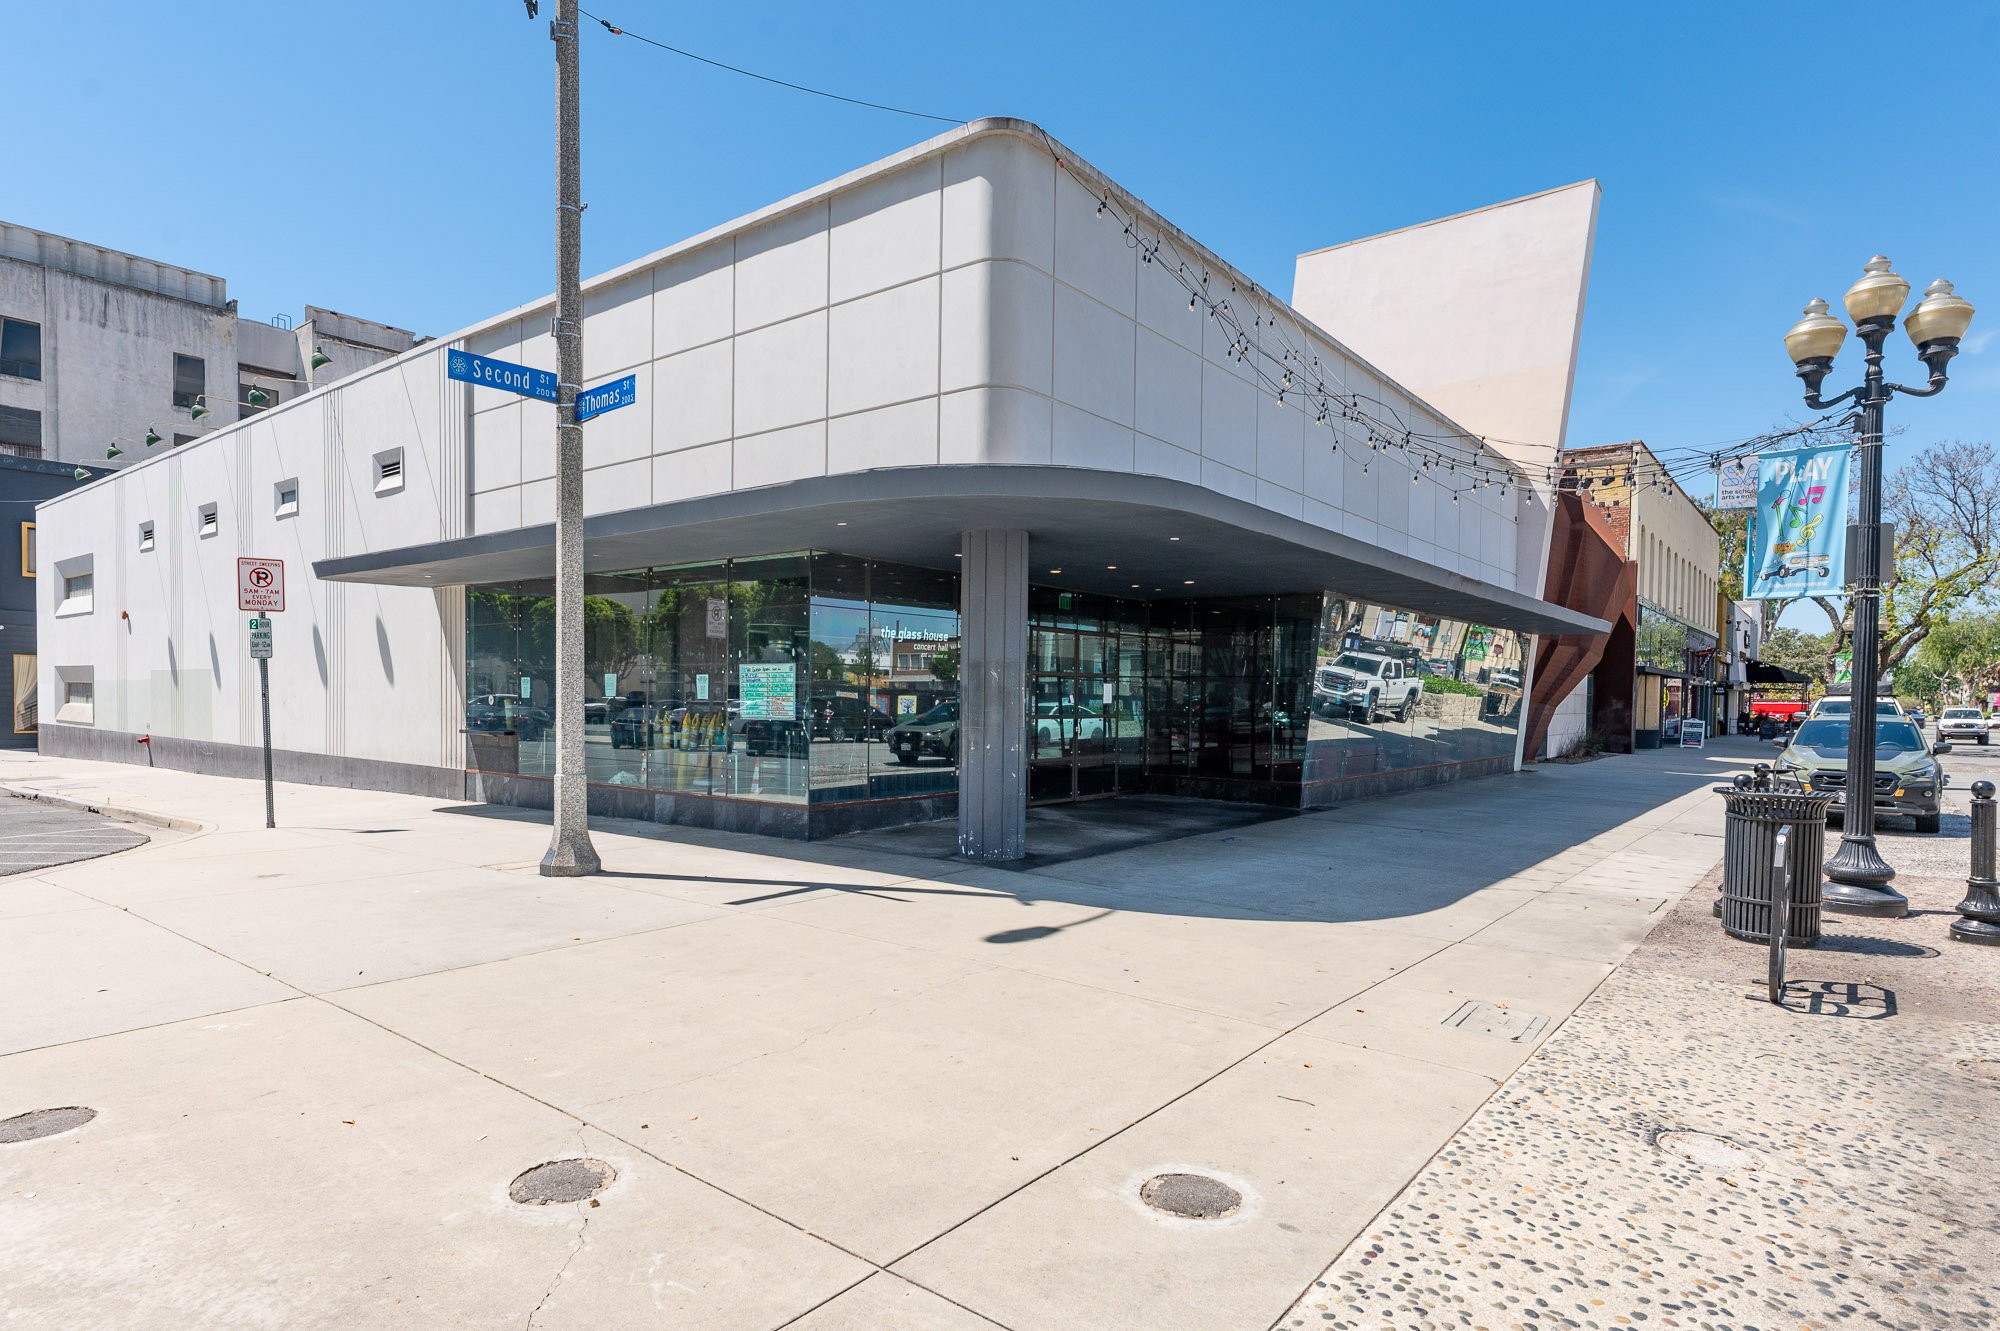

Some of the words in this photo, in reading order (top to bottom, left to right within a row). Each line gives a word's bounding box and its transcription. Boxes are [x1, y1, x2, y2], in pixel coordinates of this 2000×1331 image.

[473, 360, 530, 389] Second
[540, 374, 549, 385] St
[536, 388, 549, 397] 200
[585, 389, 620, 412] Thomas
[623, 380, 629, 390] St
[1775, 456, 1834, 485] PLAY
[251, 620, 257, 629] 2
[259, 620, 269, 628] HOUR
[251, 632, 270, 640] PARKING
[880, 626, 896, 639] the
[898, 627, 922, 642] glass
[923, 628, 949, 642] house
[913, 643, 937, 652] concert
[938, 643, 949, 652] hall
